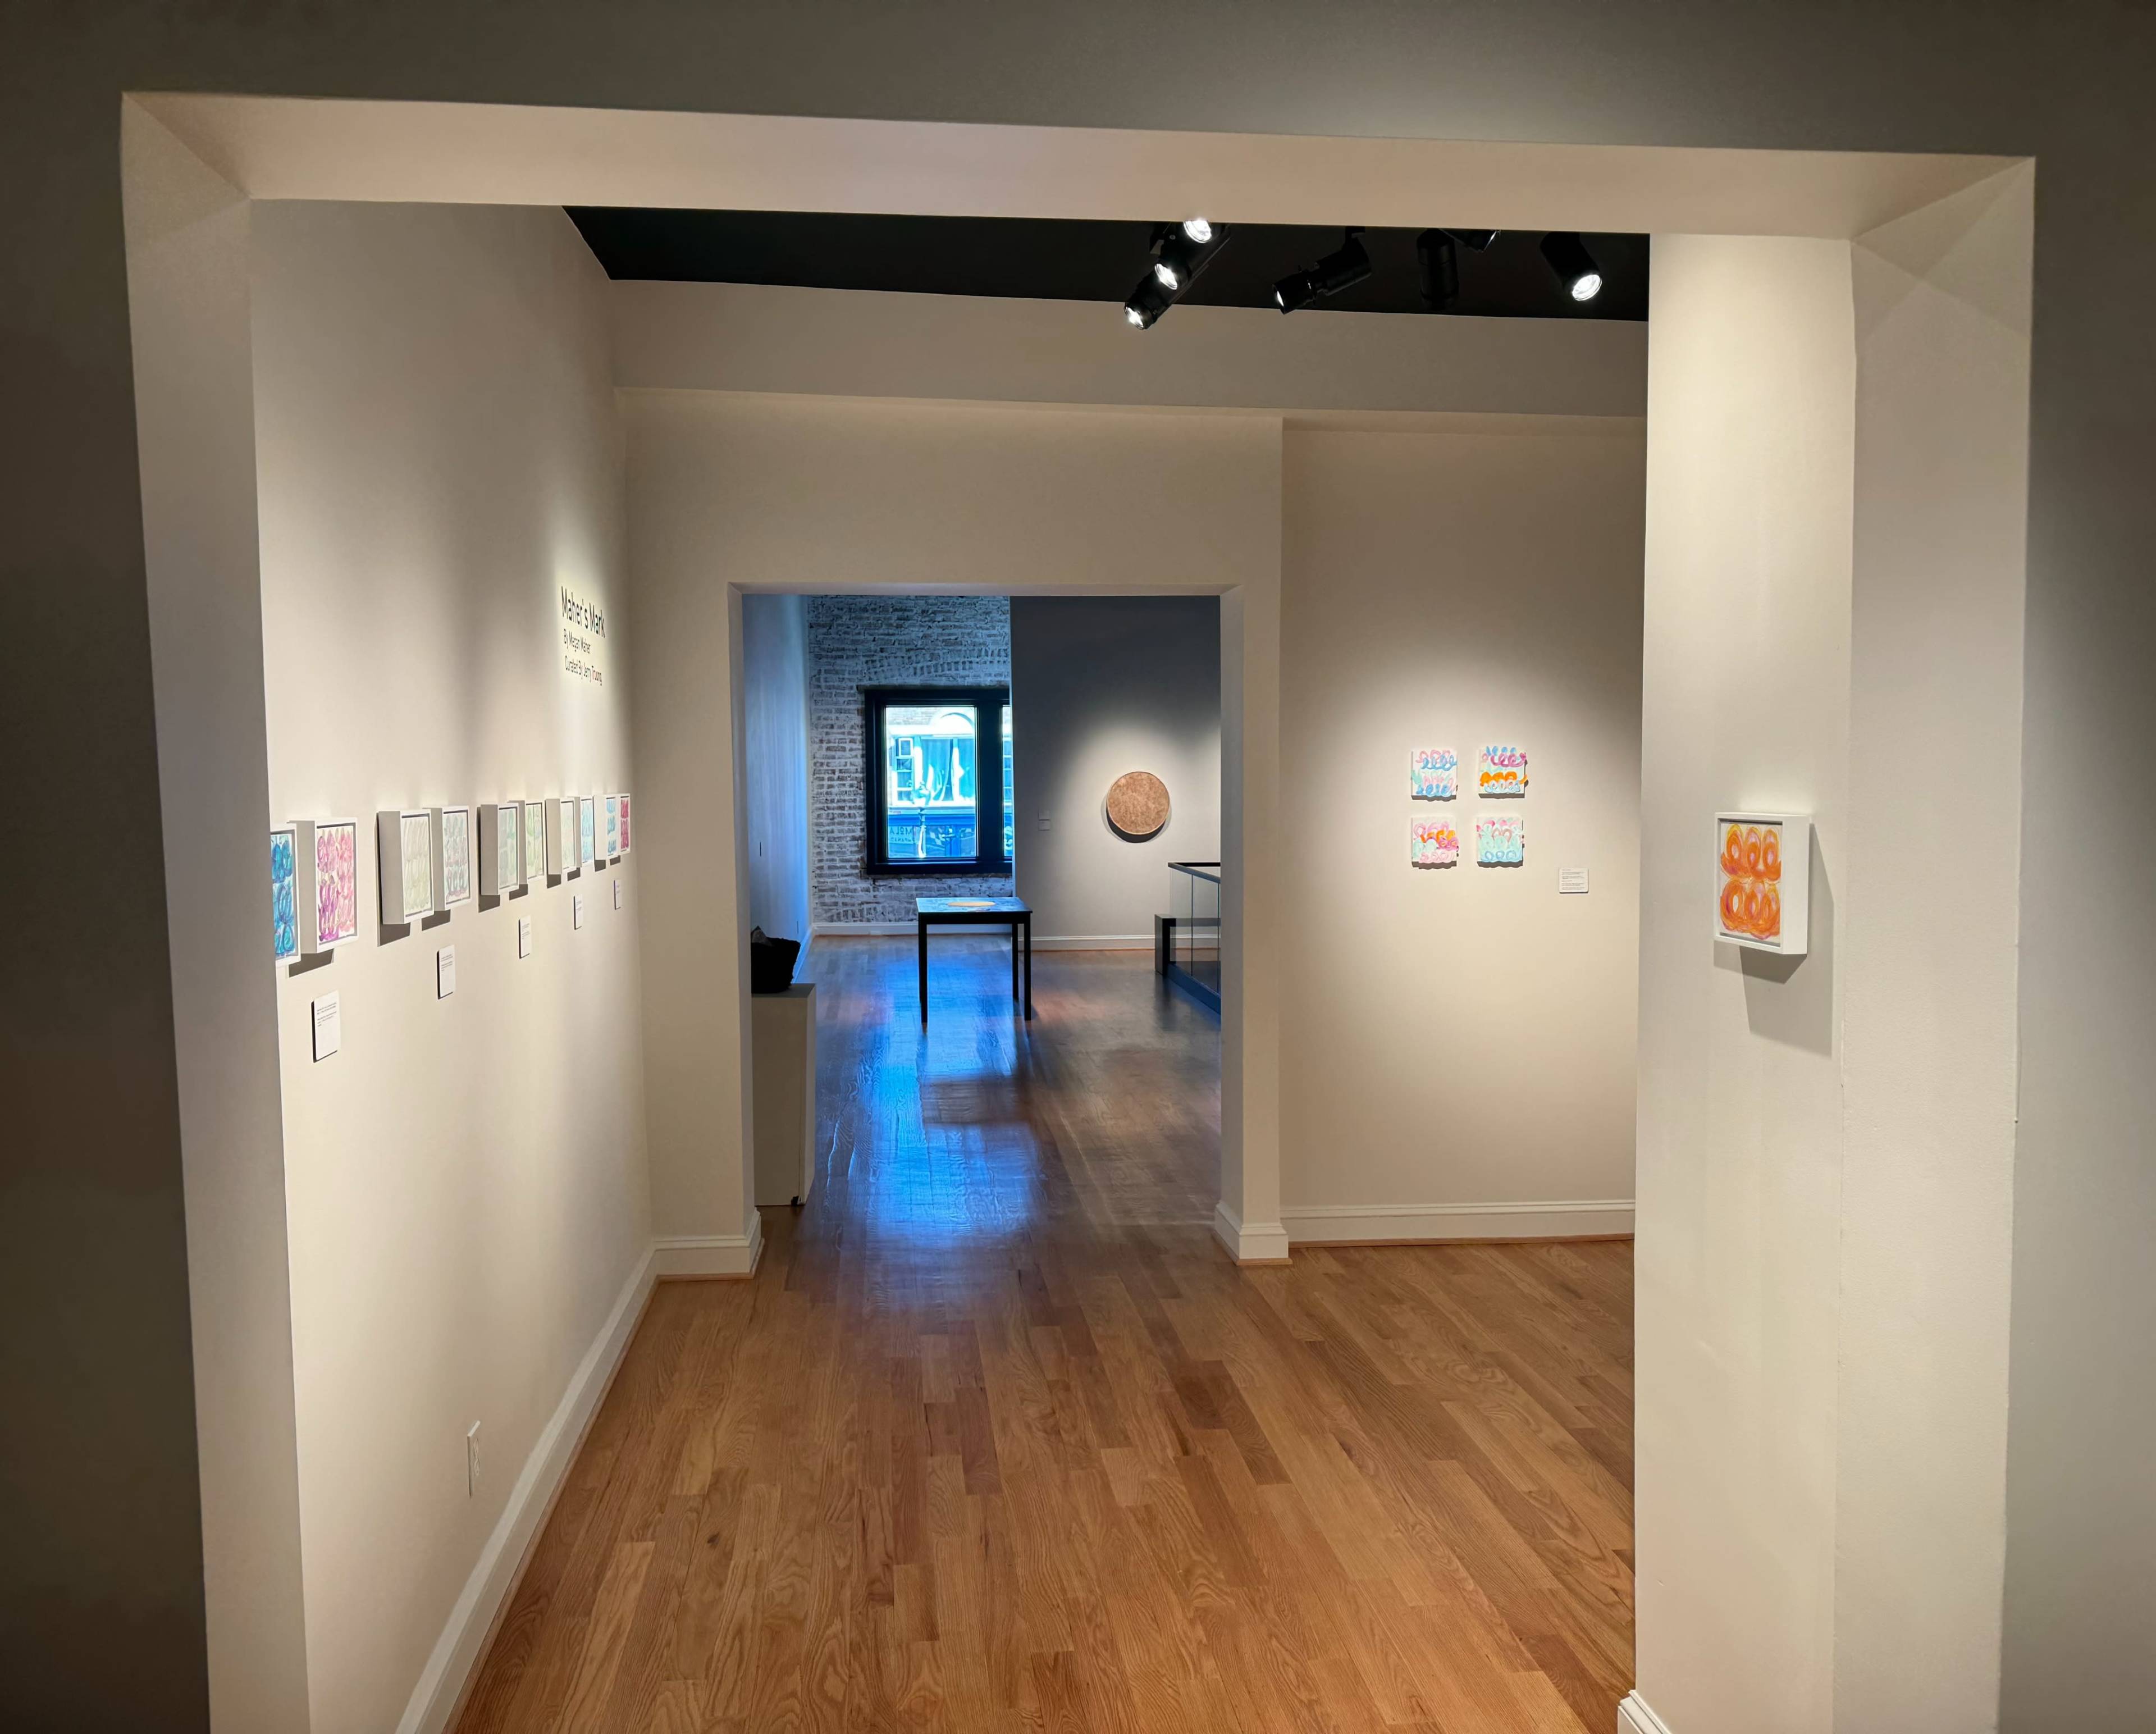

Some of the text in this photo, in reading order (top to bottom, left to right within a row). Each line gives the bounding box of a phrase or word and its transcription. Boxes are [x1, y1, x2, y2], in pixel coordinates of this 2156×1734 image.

[561, 586, 605, 638] Maher's Mark
[564, 628, 568, 649] By
[578, 660, 583, 680] By
